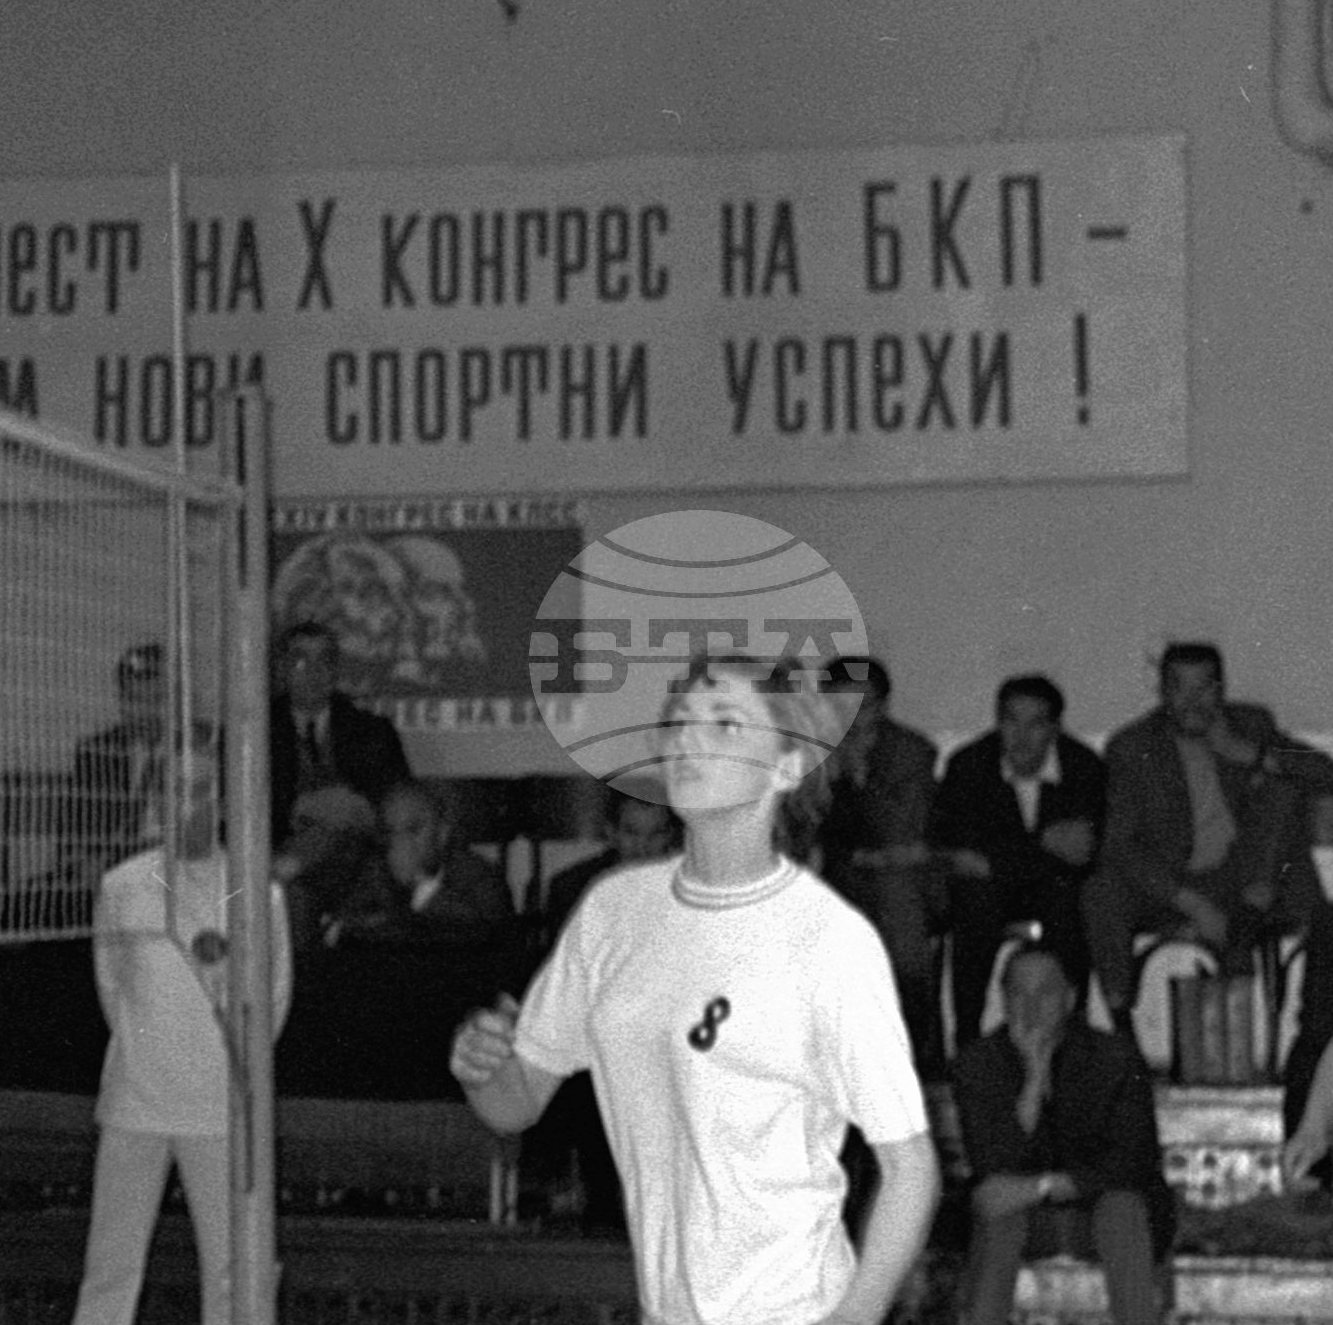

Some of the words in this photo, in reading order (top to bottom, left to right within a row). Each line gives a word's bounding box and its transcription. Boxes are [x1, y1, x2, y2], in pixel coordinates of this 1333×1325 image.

[184, 216, 264, 315] НА
[380, 203, 669, 309] КОНГРЕС
[721, 199, 801, 297] НА
[862, 174, 1043, 294] БКП
[326, 342, 647, 447] СПОРТНИ
[724, 329, 1012, 438] УСПЕХИ
[687, 995, 731, 1053] 8
